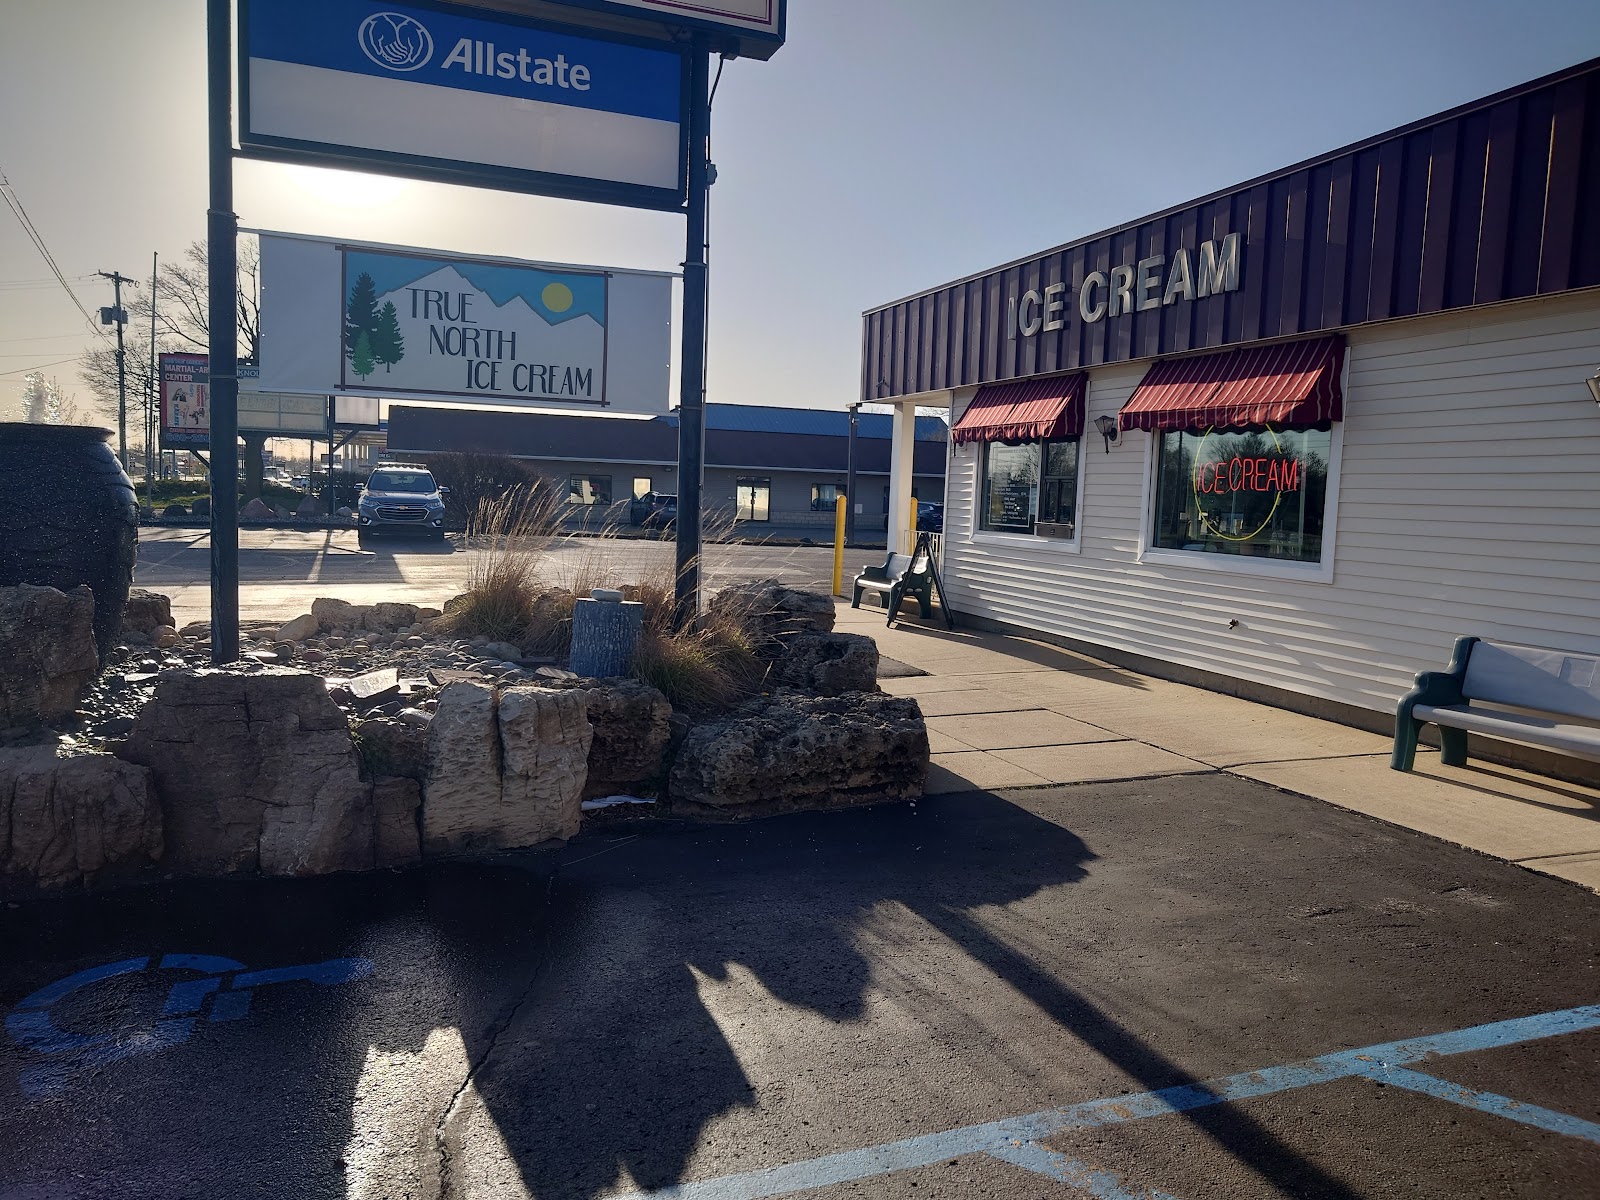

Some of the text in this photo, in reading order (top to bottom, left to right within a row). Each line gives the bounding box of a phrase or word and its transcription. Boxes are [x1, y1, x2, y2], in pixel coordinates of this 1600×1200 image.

[441, 37, 591, 92] Allstate
[1008, 233, 1241, 340] ICE CREAM
[406, 287, 477, 324] TRUE
[429, 325, 517, 361] NORTH
[165, 374, 193, 382] CENTER
[466, 359, 593, 398] ICE CREAM
[1196, 457, 1298, 494] ICE CREAM
